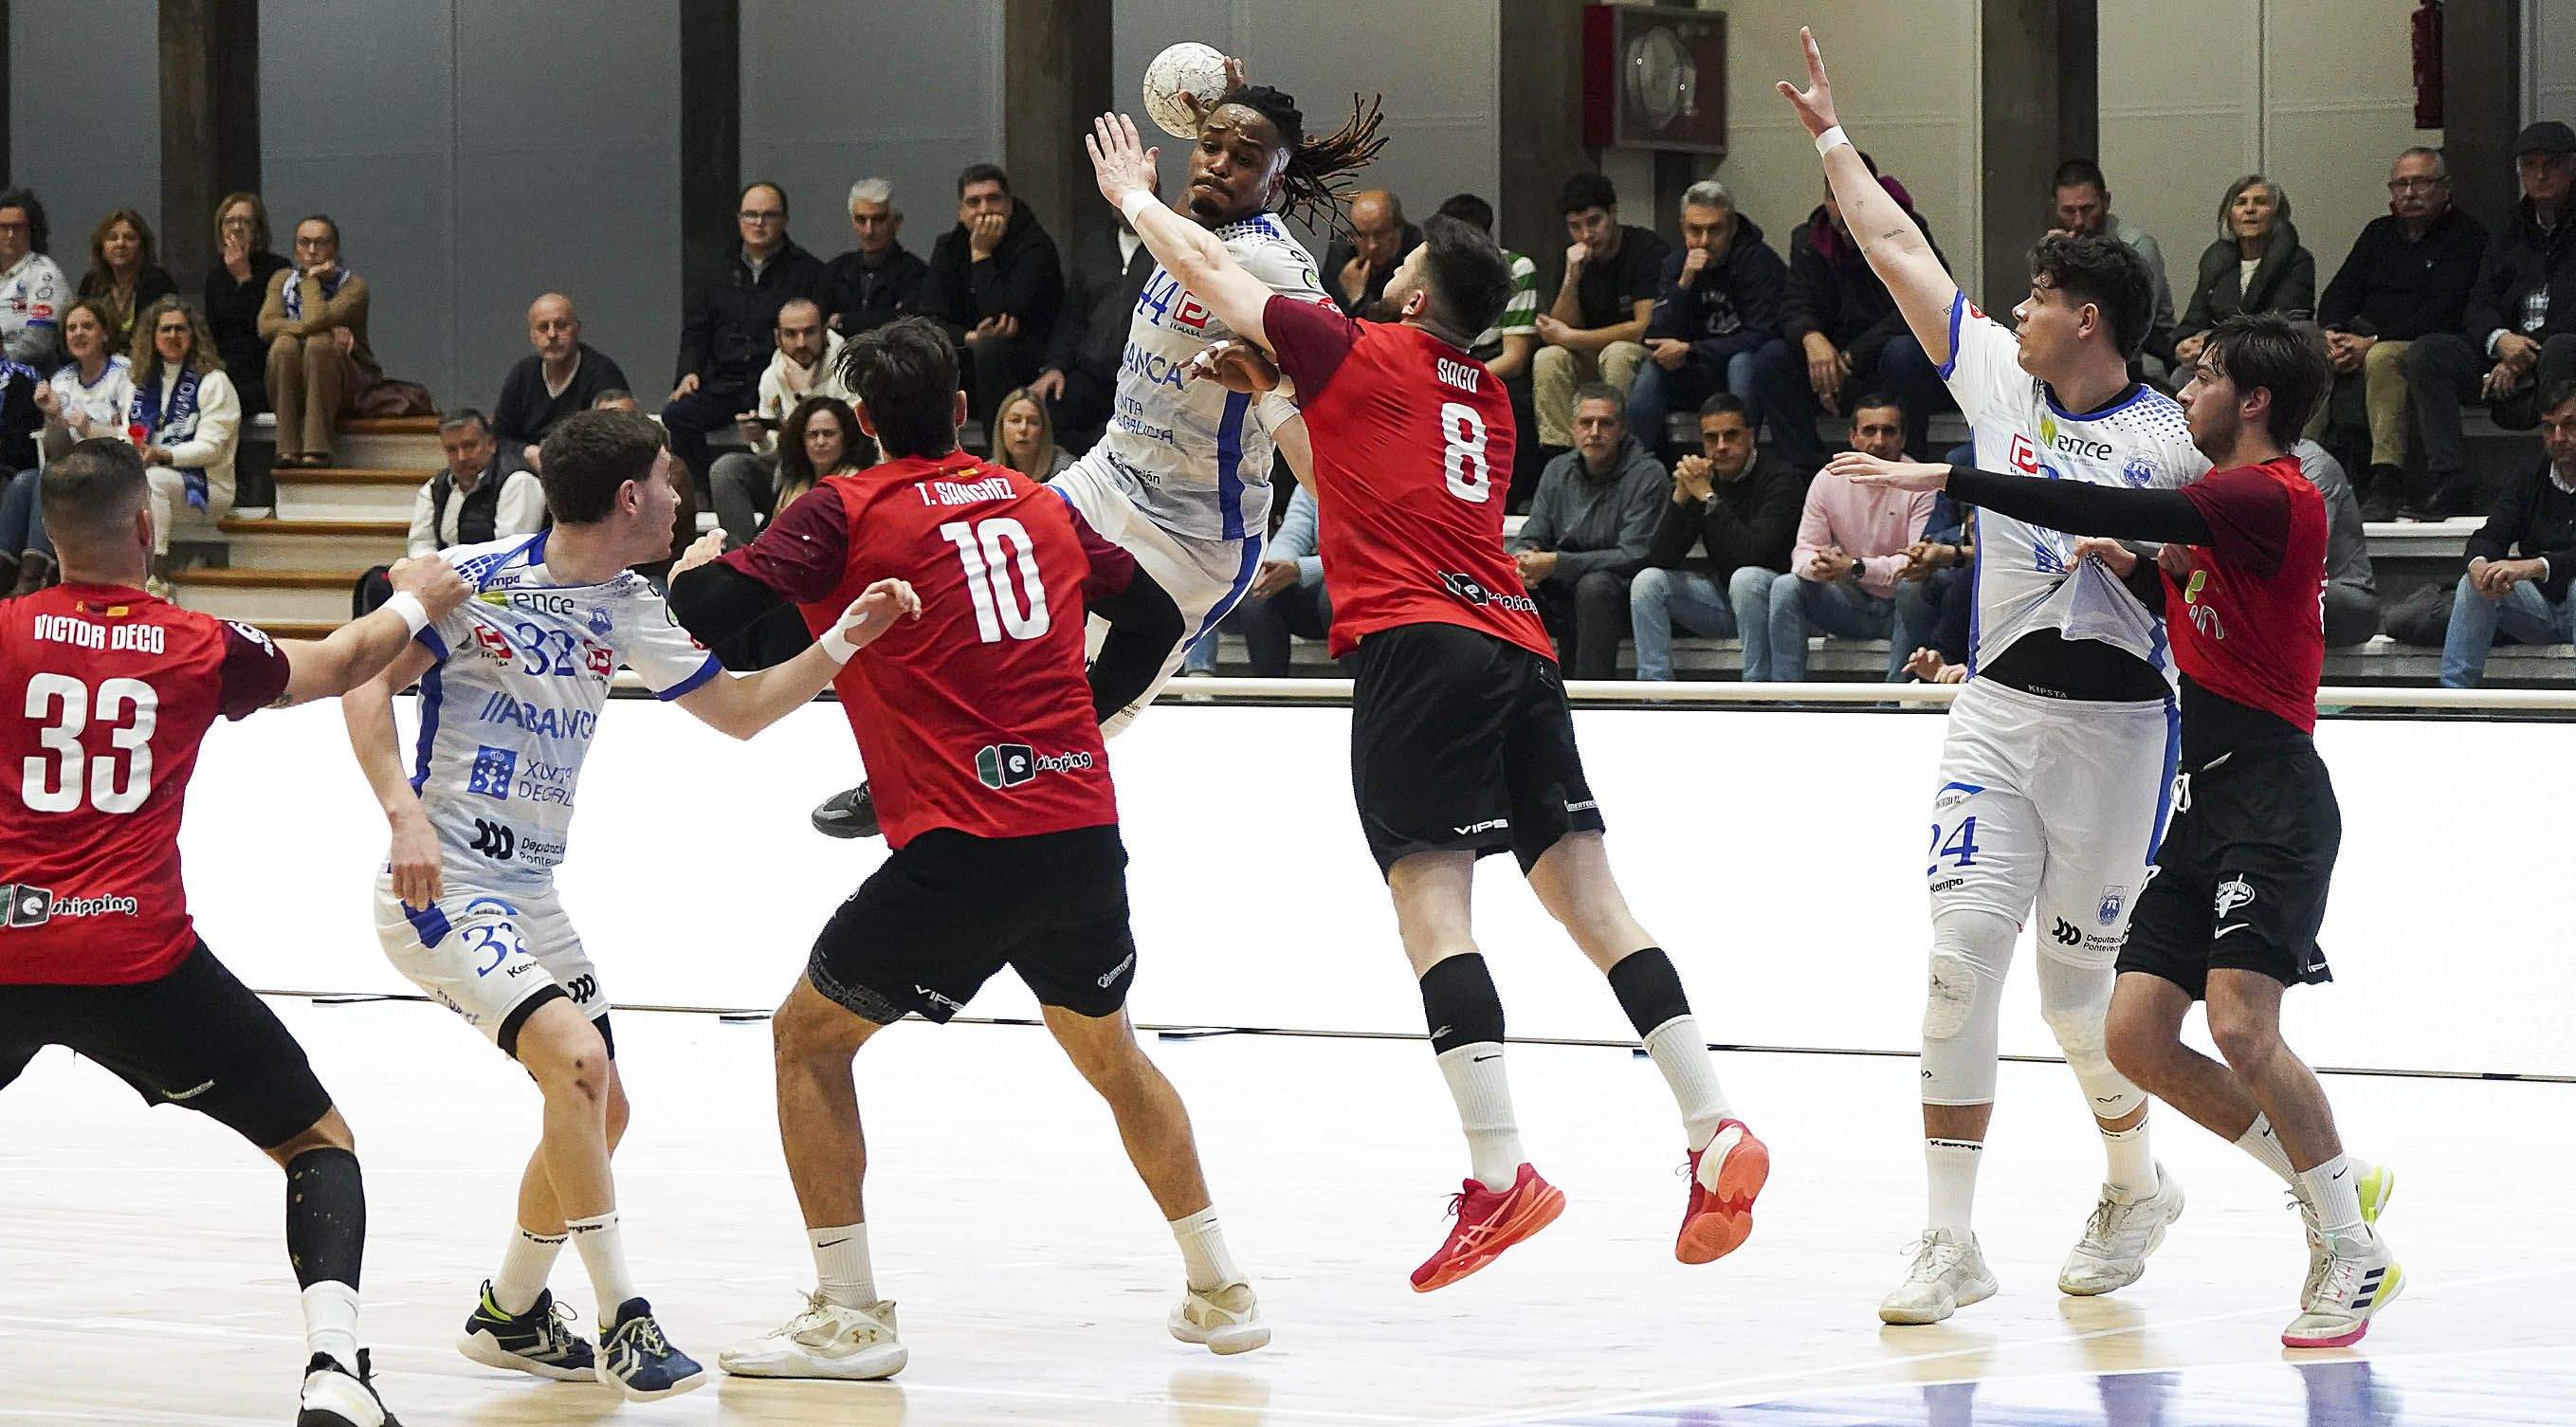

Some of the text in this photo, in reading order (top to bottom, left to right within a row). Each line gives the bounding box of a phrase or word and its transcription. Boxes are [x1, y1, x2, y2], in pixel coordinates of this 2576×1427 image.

[1137, 270, 1180, 326] 44
[1124, 342, 1184, 391] ANCA
[1437, 357, 1479, 393] SACO
[1440, 402, 1491, 503] 8
[2057, 434, 2112, 461] ence
[914, 477, 1017, 506] T. SANCHEZ
[487, 575, 521, 586] mpa
[940, 518, 1050, 643] 10
[513, 592, 575, 615] ence
[34, 613, 165, 655] VICTOR DECO
[514, 622, 576, 677] 32
[2028, 684, 2068, 699] KIPSTA
[491, 696, 597, 739] ABANC
[22, 672, 159, 814] 33
[1453, 818, 1508, 835] VIPS
